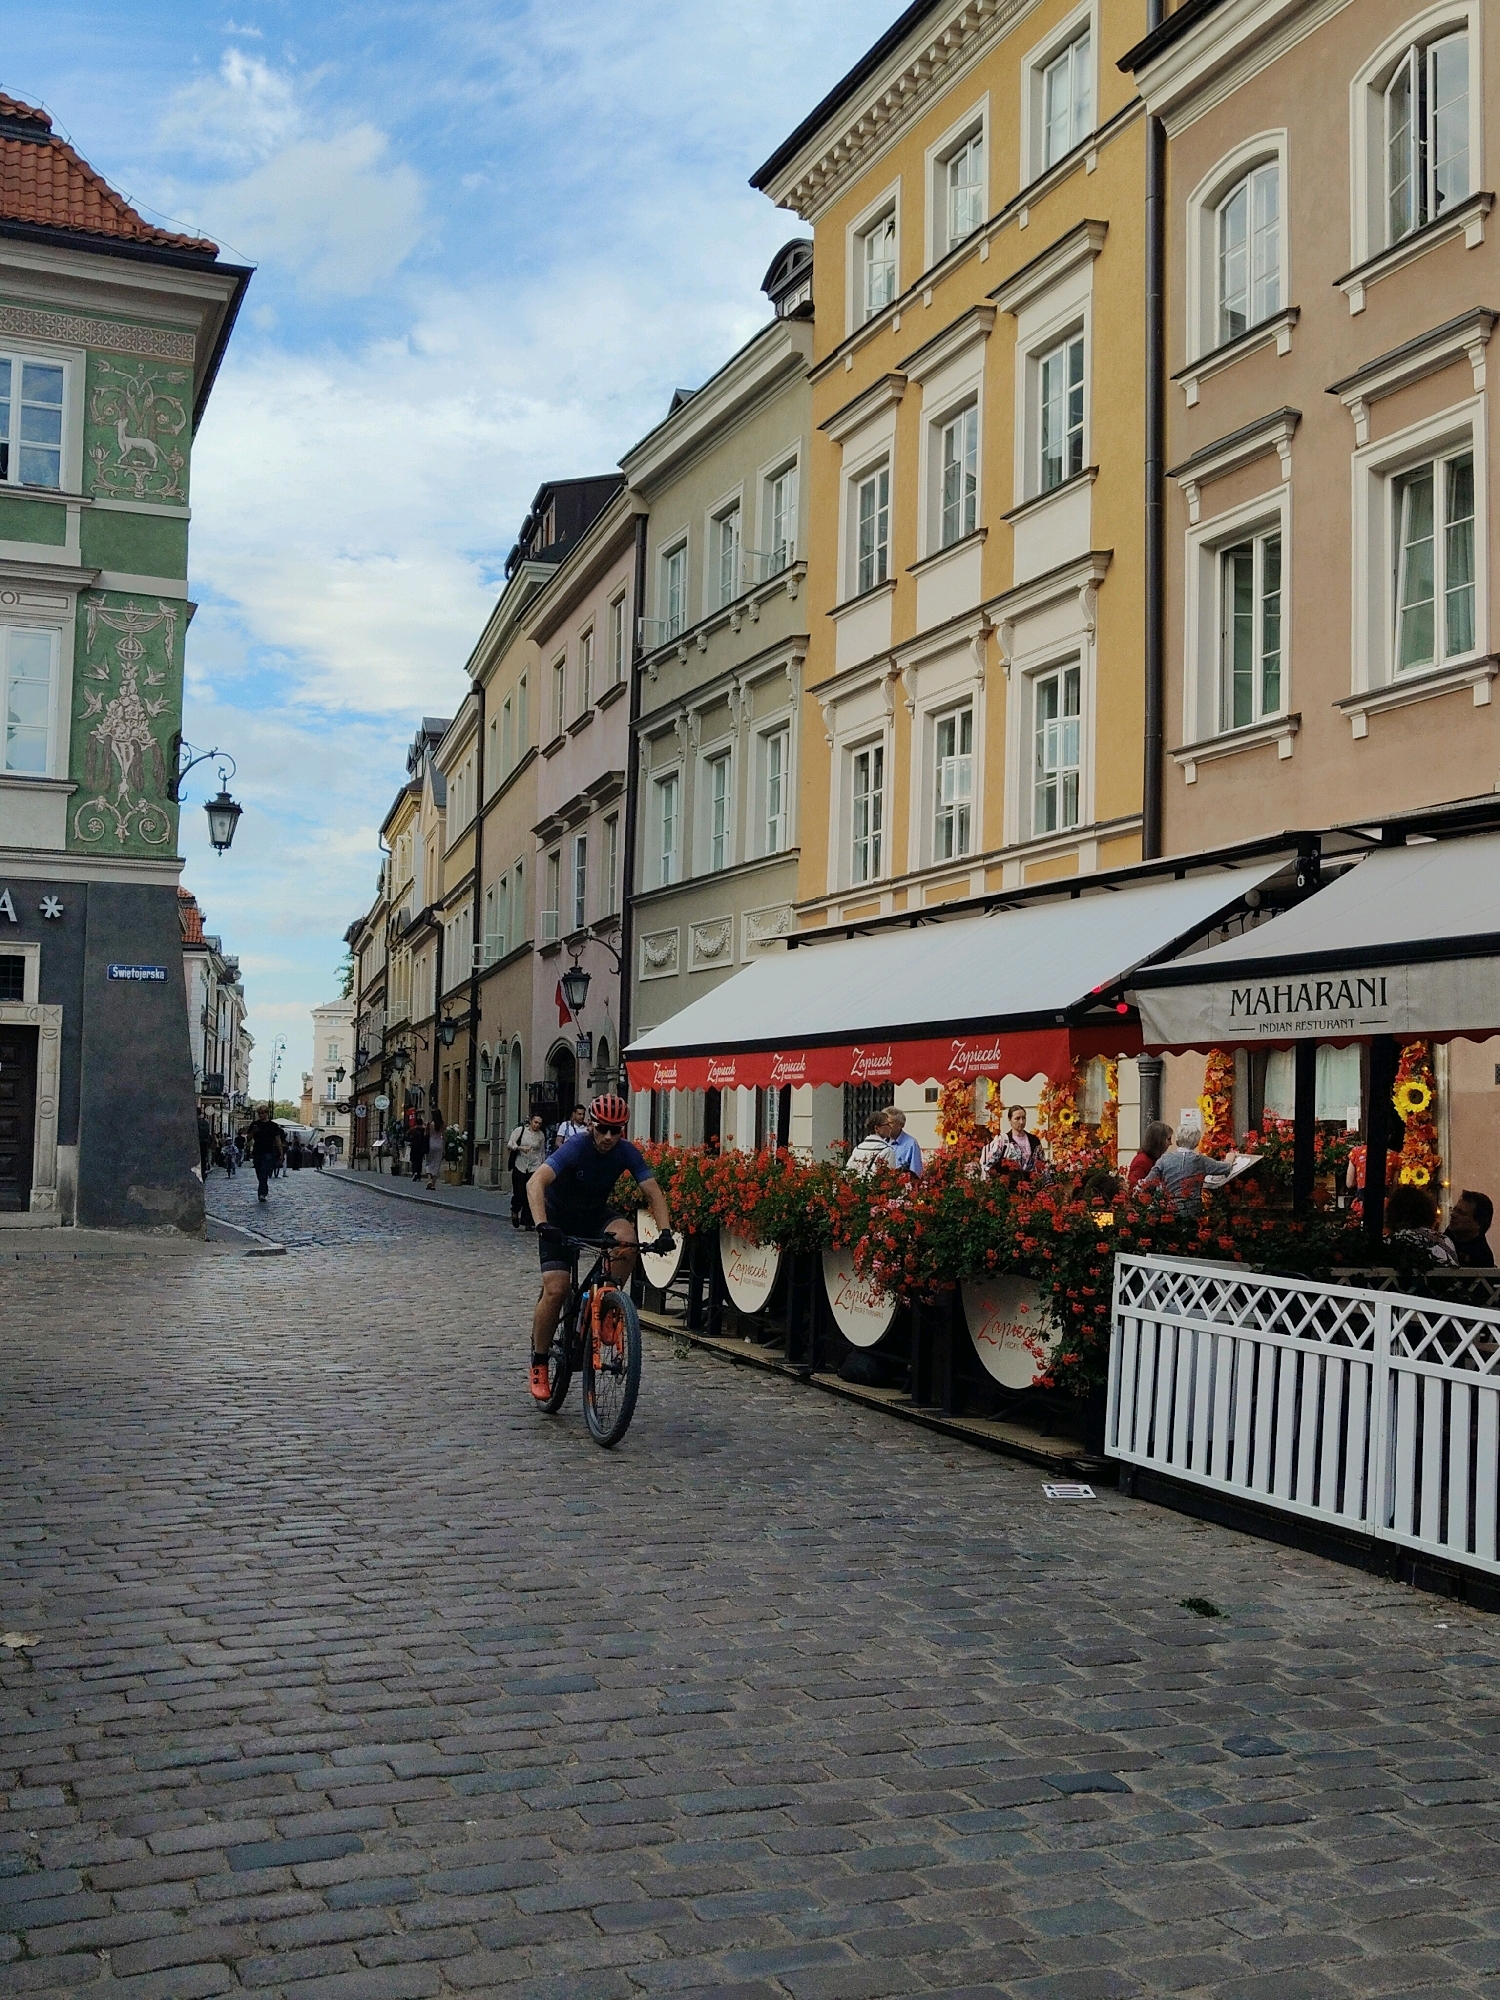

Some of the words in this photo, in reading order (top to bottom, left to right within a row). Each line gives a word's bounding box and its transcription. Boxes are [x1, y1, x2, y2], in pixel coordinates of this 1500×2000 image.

[112, 964, 165, 981] Świętojerska
[1230, 977, 1388, 1017] MAHARANI
[1259, 1022, 1293, 1033] INDIAN
[1295, 1018, 1355, 1031] RESTURANT
[770, 1053, 806, 1082] Zapiecek
[850, 1046, 893, 1079] Zapiecek
[947, 1038, 1001, 1075] Zapiecek
